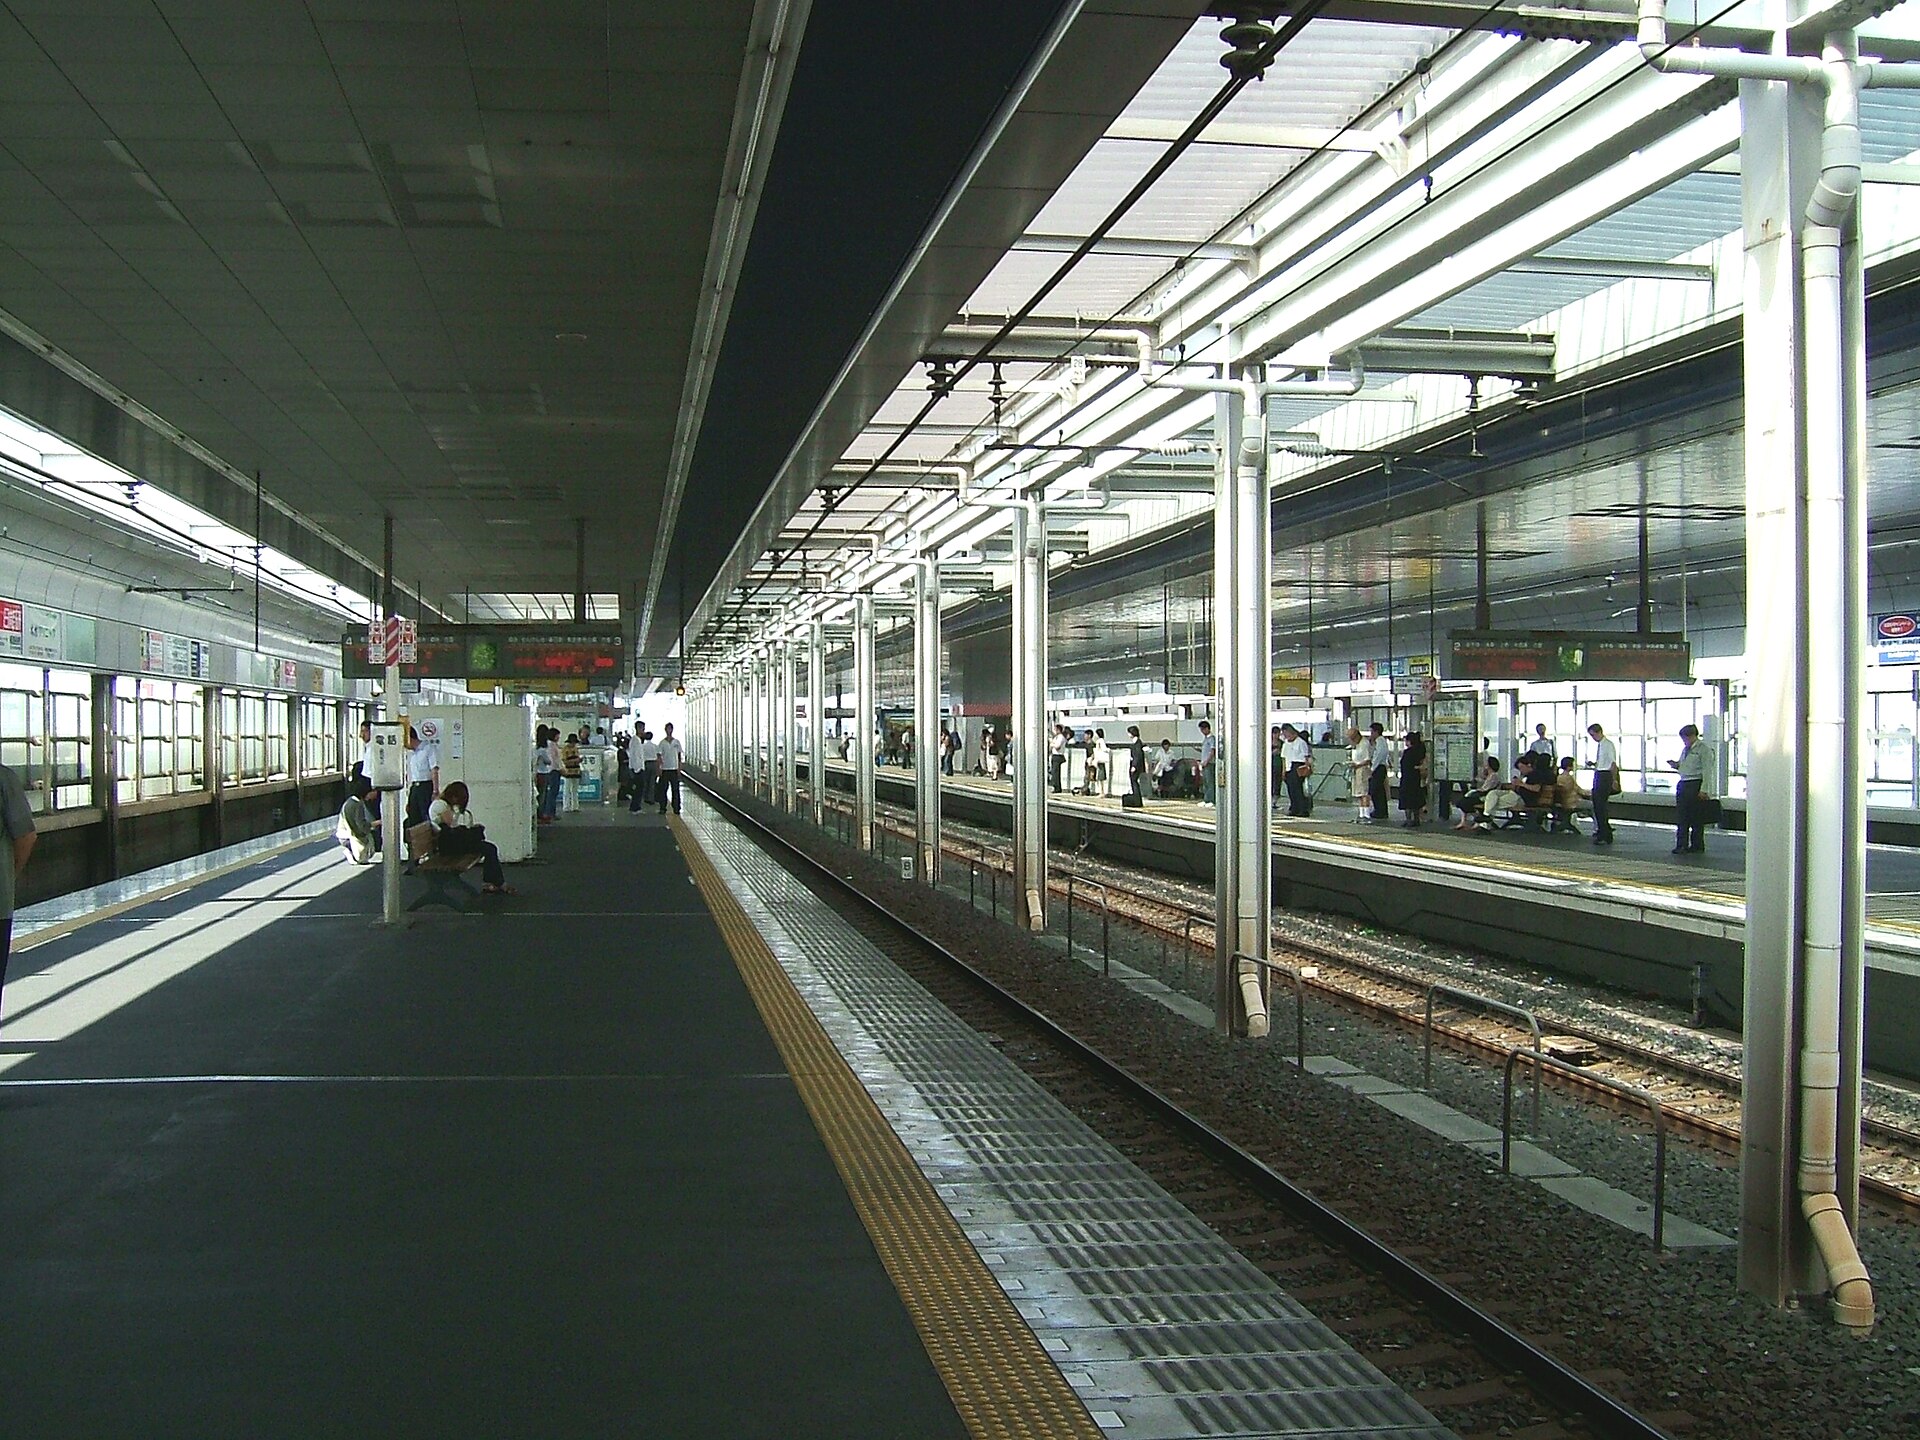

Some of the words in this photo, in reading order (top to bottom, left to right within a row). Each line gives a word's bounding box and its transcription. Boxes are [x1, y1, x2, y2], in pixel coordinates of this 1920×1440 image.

[345, 636, 353, 645] 4
[613, 637, 622, 646] 3
[1454, 642, 1461, 651] 2
[639, 662, 646, 672] 3
[1170, 680, 1177, 690] 2
